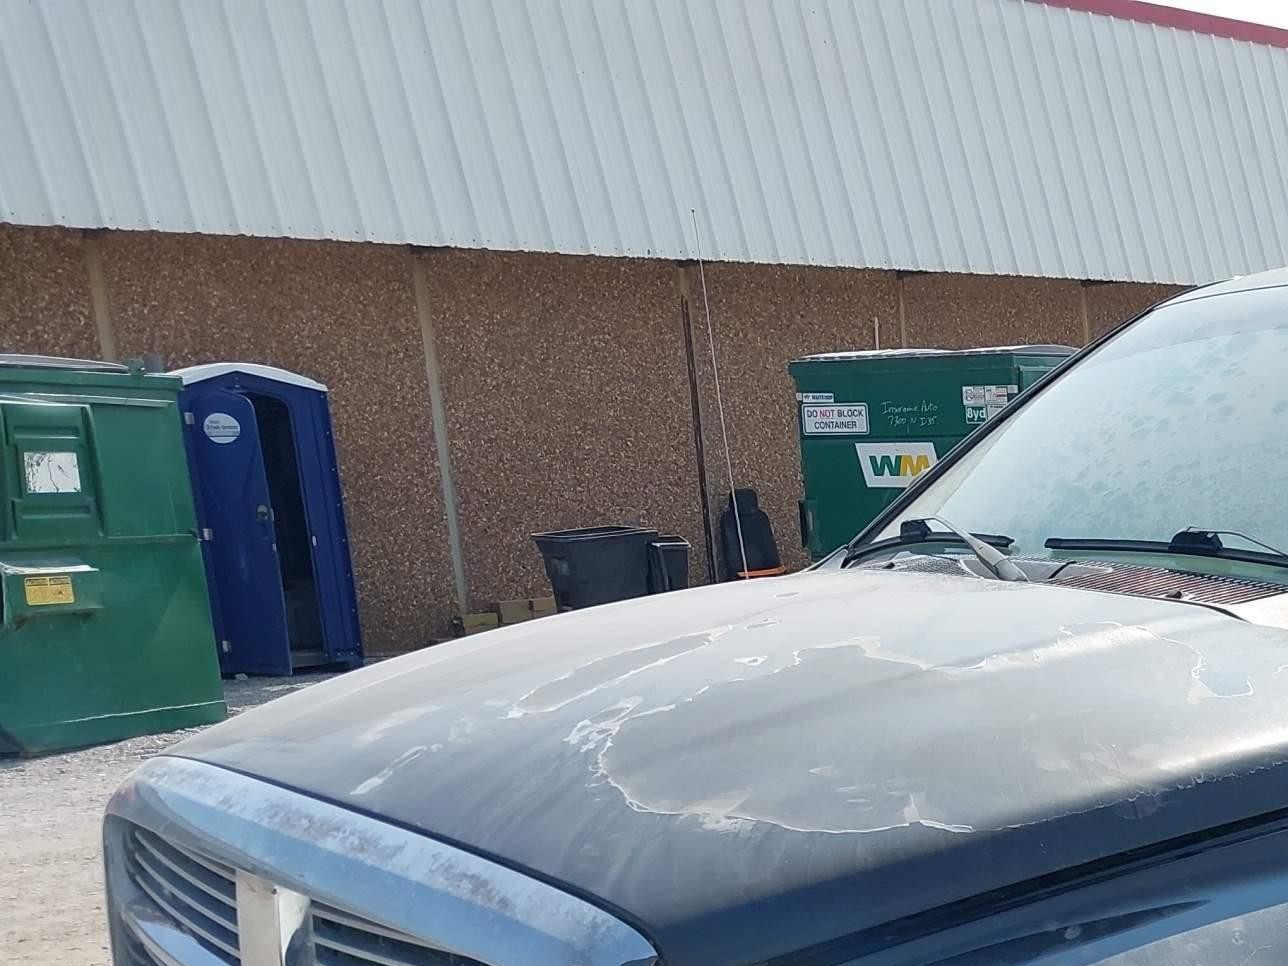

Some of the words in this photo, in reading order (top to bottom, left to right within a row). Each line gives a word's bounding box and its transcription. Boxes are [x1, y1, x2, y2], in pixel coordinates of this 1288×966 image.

[807, 409, 818, 418] DO
[819, 409, 835, 418] NOT
[837, 408, 864, 418] BLOCK
[967, 407, 986, 421] 8yd
[814, 420, 857, 430] CONTAINER
[868, 454, 930, 477] WM
